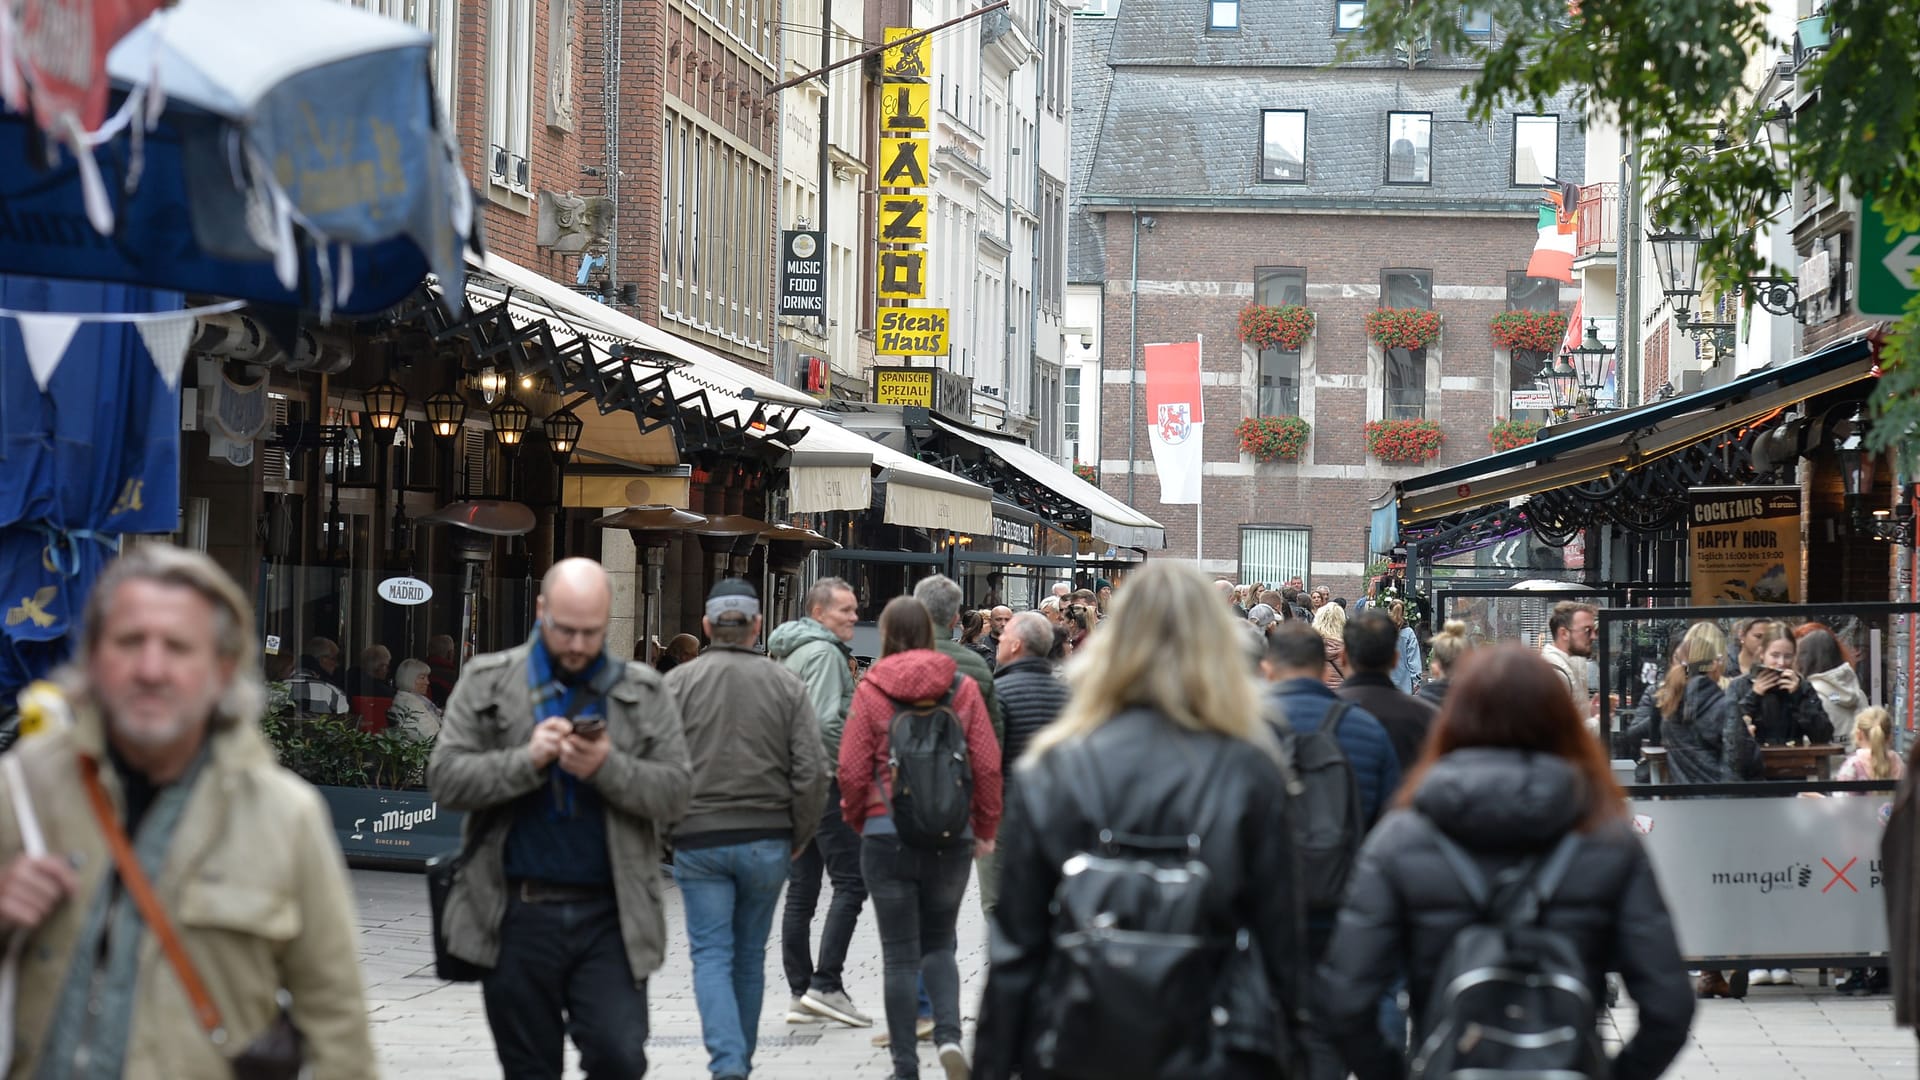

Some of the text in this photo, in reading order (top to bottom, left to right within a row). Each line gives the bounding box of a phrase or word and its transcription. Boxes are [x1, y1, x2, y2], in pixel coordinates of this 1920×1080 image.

[882, 86, 927, 296] LAZO
[787, 261, 820, 274] MUSIC
[789, 278, 817, 292] FOOD
[783, 295, 822, 309] DRINKS
[881, 313, 945, 332] Steak
[882, 333, 941, 352] Haus
[881, 373, 929, 383] SPANISCHE
[886, 397, 922, 407] TÄTEN
[1694, 498, 1764, 522] COCKTAILS
[1697, 530, 1777, 549] HAPPY HOUR
[389, 585, 424, 600] MADRID
[1712, 865, 1794, 894] mangal
